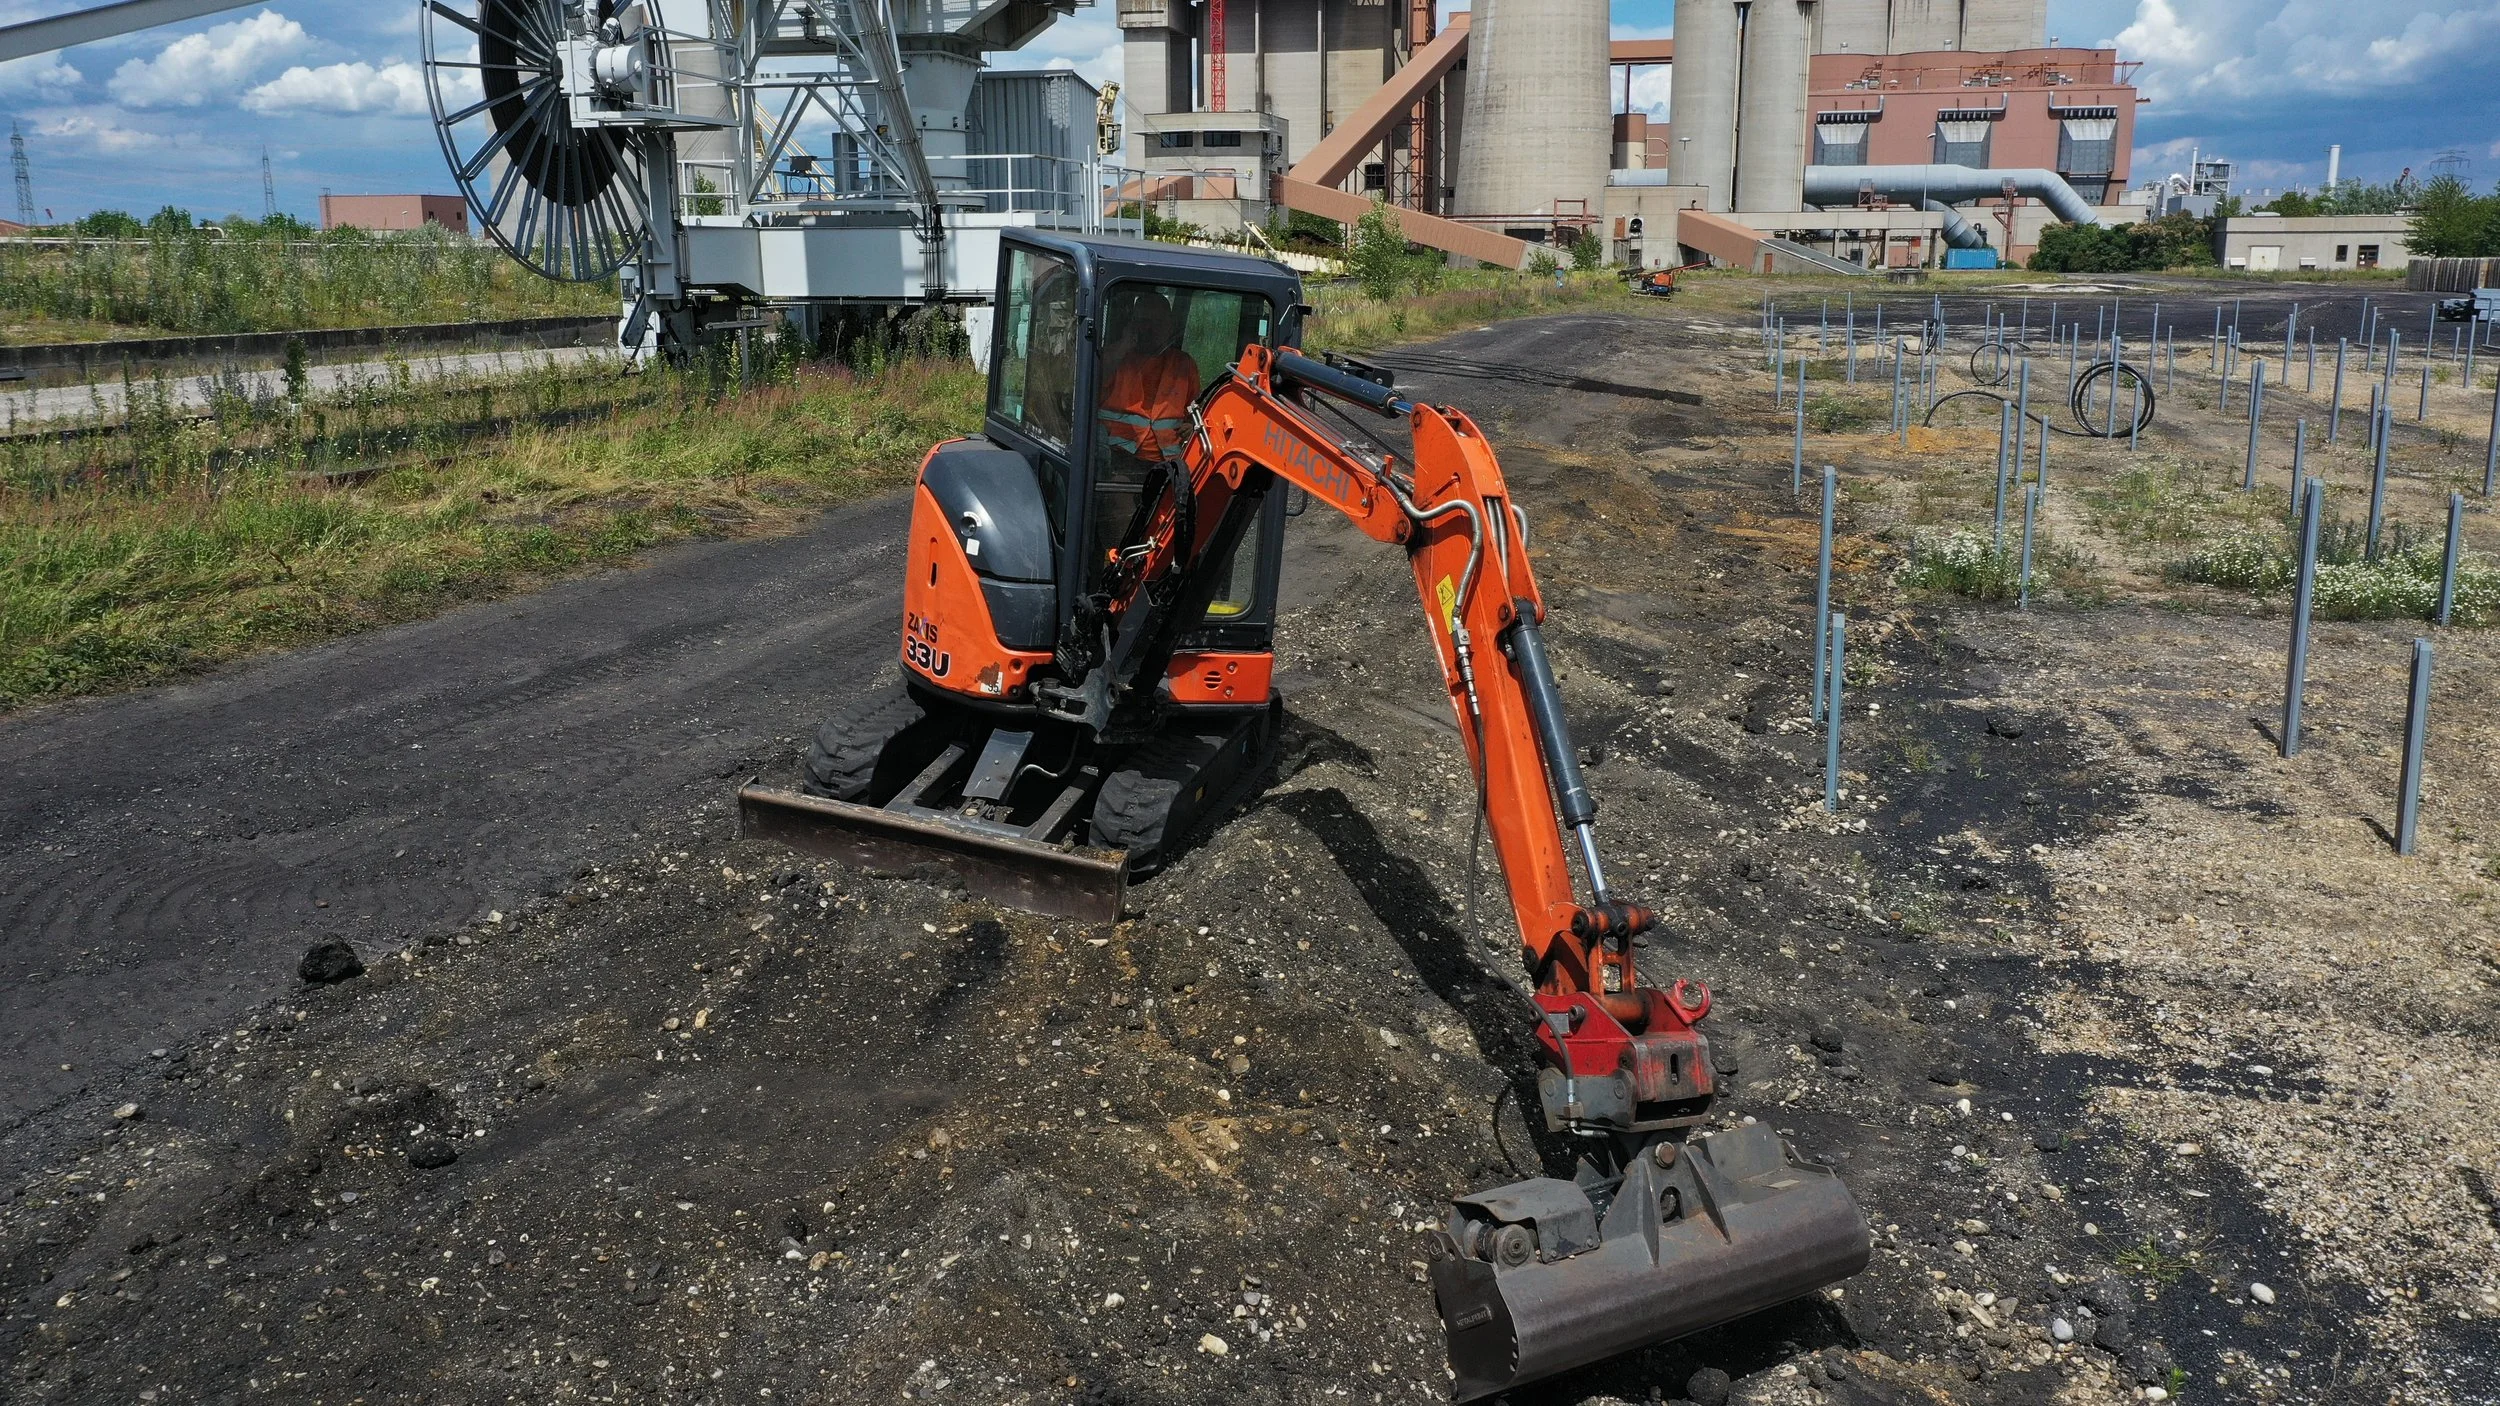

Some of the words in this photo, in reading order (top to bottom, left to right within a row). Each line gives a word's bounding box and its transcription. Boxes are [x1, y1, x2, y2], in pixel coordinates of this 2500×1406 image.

[1264, 421, 1351, 503] HITACHI
[907, 612, 938, 644] ZAXIS
[906, 635, 950, 678] 33U
